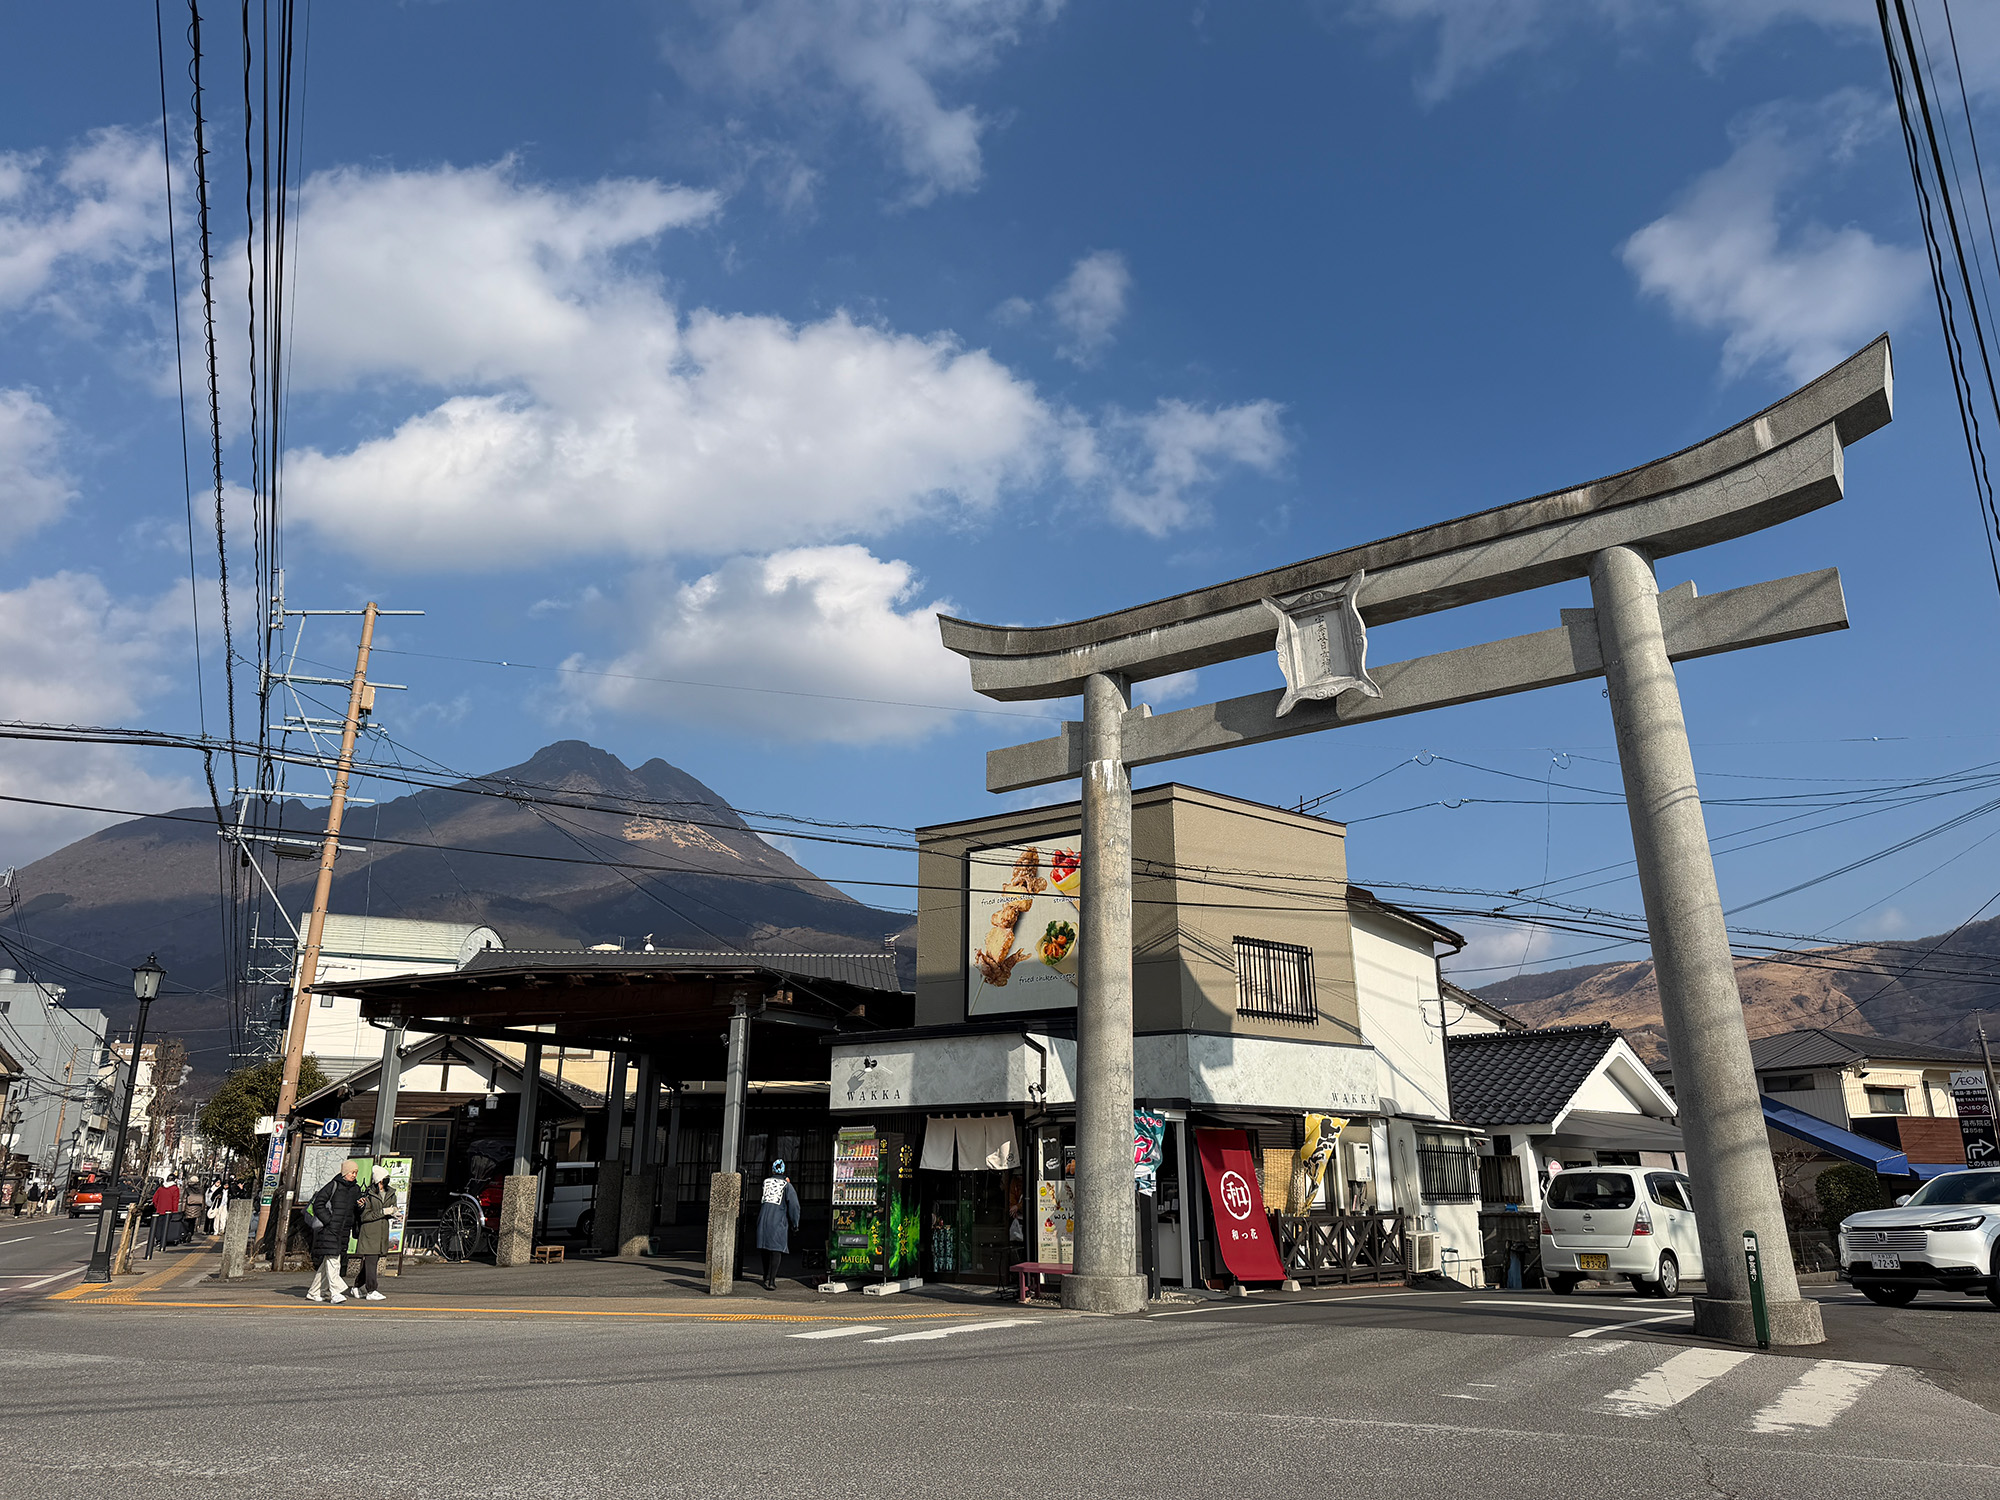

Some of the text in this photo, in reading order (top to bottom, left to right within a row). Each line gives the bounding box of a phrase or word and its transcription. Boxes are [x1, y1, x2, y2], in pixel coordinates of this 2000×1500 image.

[981, 897, 995, 907] fried
[1019, 976, 1035, 986] fried
[847, 1089, 901, 1101] WAKKA
[1331, 1092, 1376, 1105] WAKKA
[383, 1160, 403, 1169] 人力車
[1226, 1181, 1249, 1208] 和
[1231, 1227, 1259, 1241] 和っ花
[841, 1255, 870, 1264] MATCHA
[1878, 1259, 1899, 1269] 72-93
